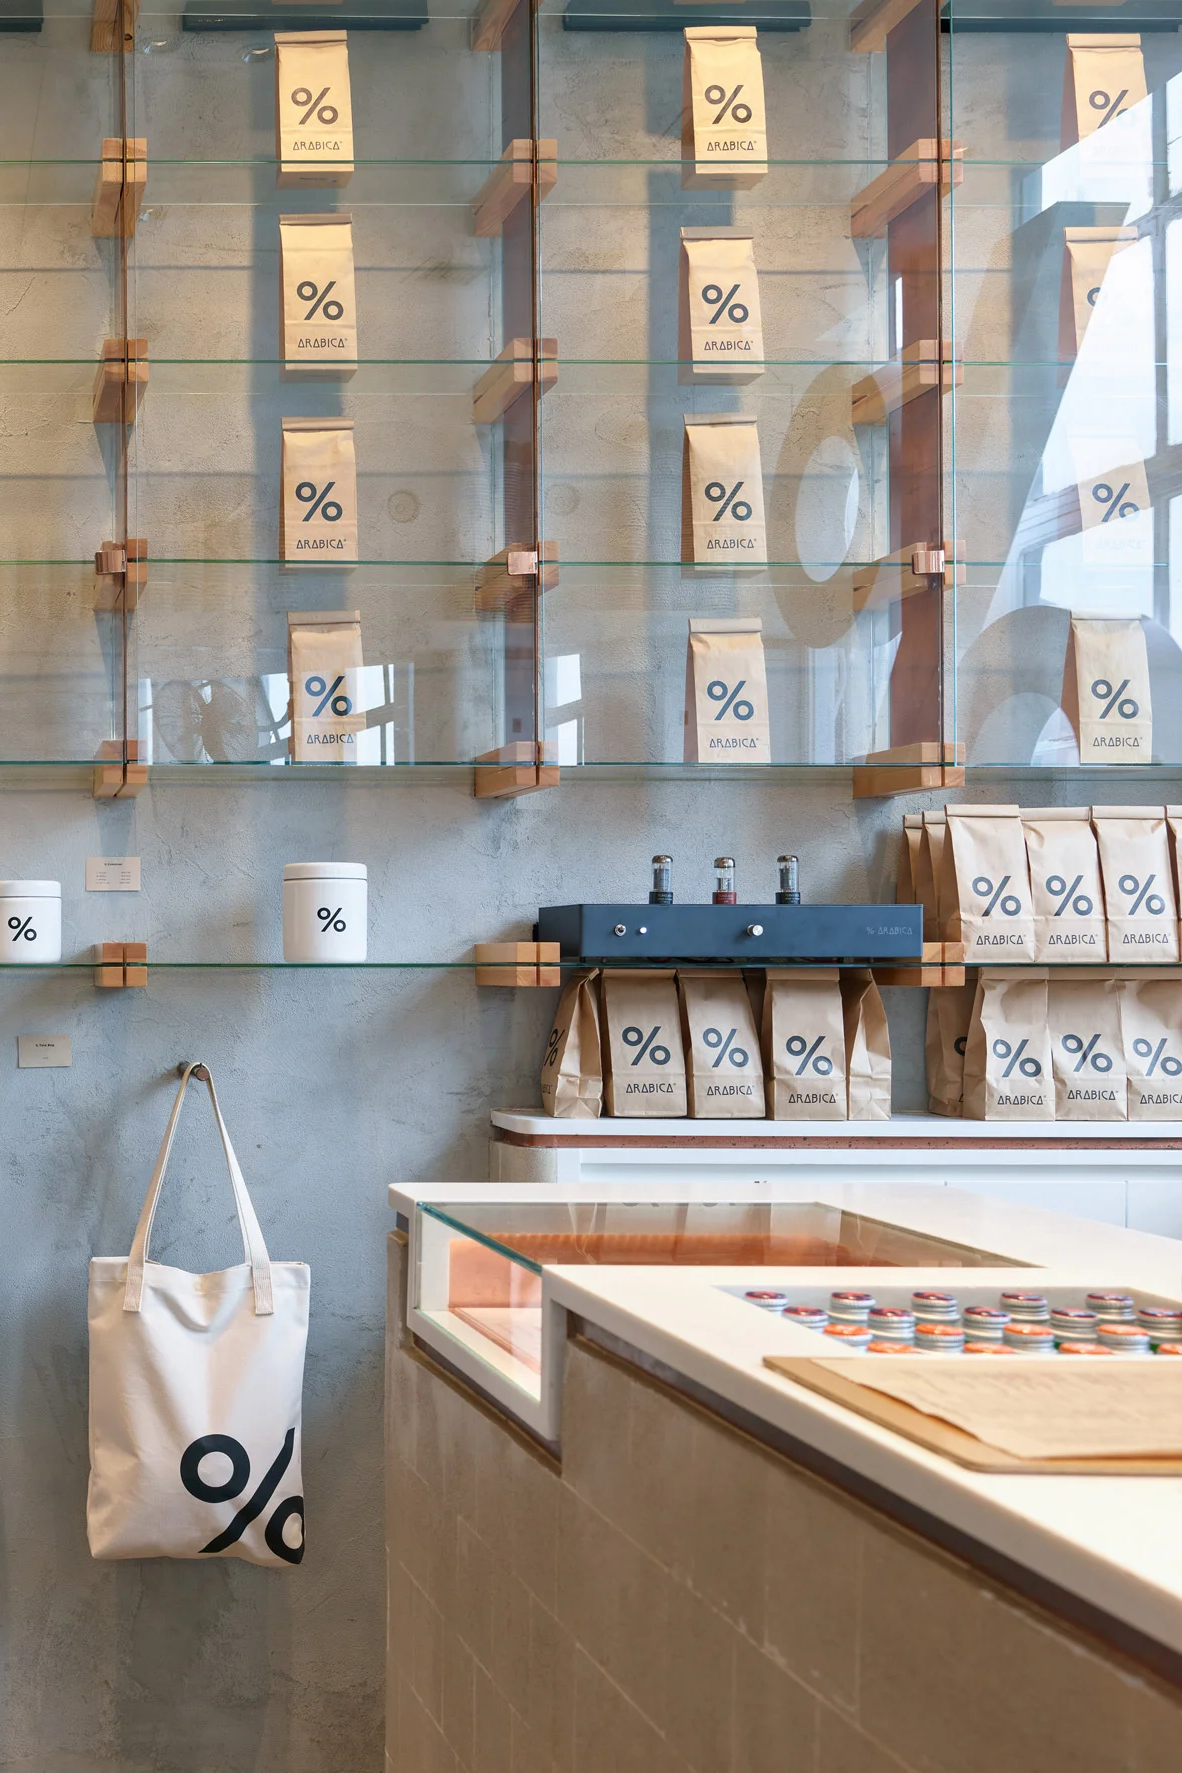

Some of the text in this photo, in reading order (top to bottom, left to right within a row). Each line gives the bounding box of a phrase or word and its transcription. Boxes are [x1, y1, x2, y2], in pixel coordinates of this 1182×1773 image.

[291, 87, 338, 125] %
[705, 85, 752, 124] %
[292, 140, 340, 151] ARABICA
[706, 140, 755, 152] ARABICA
[297, 281, 343, 320] %
[702, 284, 748, 324] %
[297, 337, 345, 349] ARABICA
[703, 340, 751, 351] ARABICA
[295, 482, 342, 522] %
[705, 482, 752, 521] %
[296, 538, 344, 550] ARABICA
[706, 538, 755, 550] ARABICA
[305, 676, 352, 716] %
[707, 681, 754, 720] %
[1091, 679, 1139, 719] %
[306, 733, 354, 745] ARABICA
[709, 737, 757, 749] ARABICA
[1092, 736, 1140, 748] ARABICA
[972, 876, 1021, 917] %
[1046, 875, 1093, 916] %
[1119, 875, 1165, 915] %
[8, 917, 37, 941] %
[317, 908, 346, 932] %
[877, 926, 913, 935] ARABICA
[975, 934, 1024, 946] ARABICA
[1048, 934, 1096, 945] ARABICA
[1122, 933, 1169, 945] ARABICA
[622, 1026, 671, 1065] %
[703, 1028, 749, 1068] %
[786, 1036, 832, 1075] %
[1061, 1034, 1112, 1073] %
[1133, 1038, 1182, 1077] %
[993, 1039, 1043, 1077] %
[625, 1082, 674, 1094] ARABICA
[706, 1085, 753, 1096] ARABICA
[788, 1093, 837, 1104] ARABICA
[997, 1094, 1044, 1106] ARABICA
[1067, 1089, 1116, 1101] ARABICA
